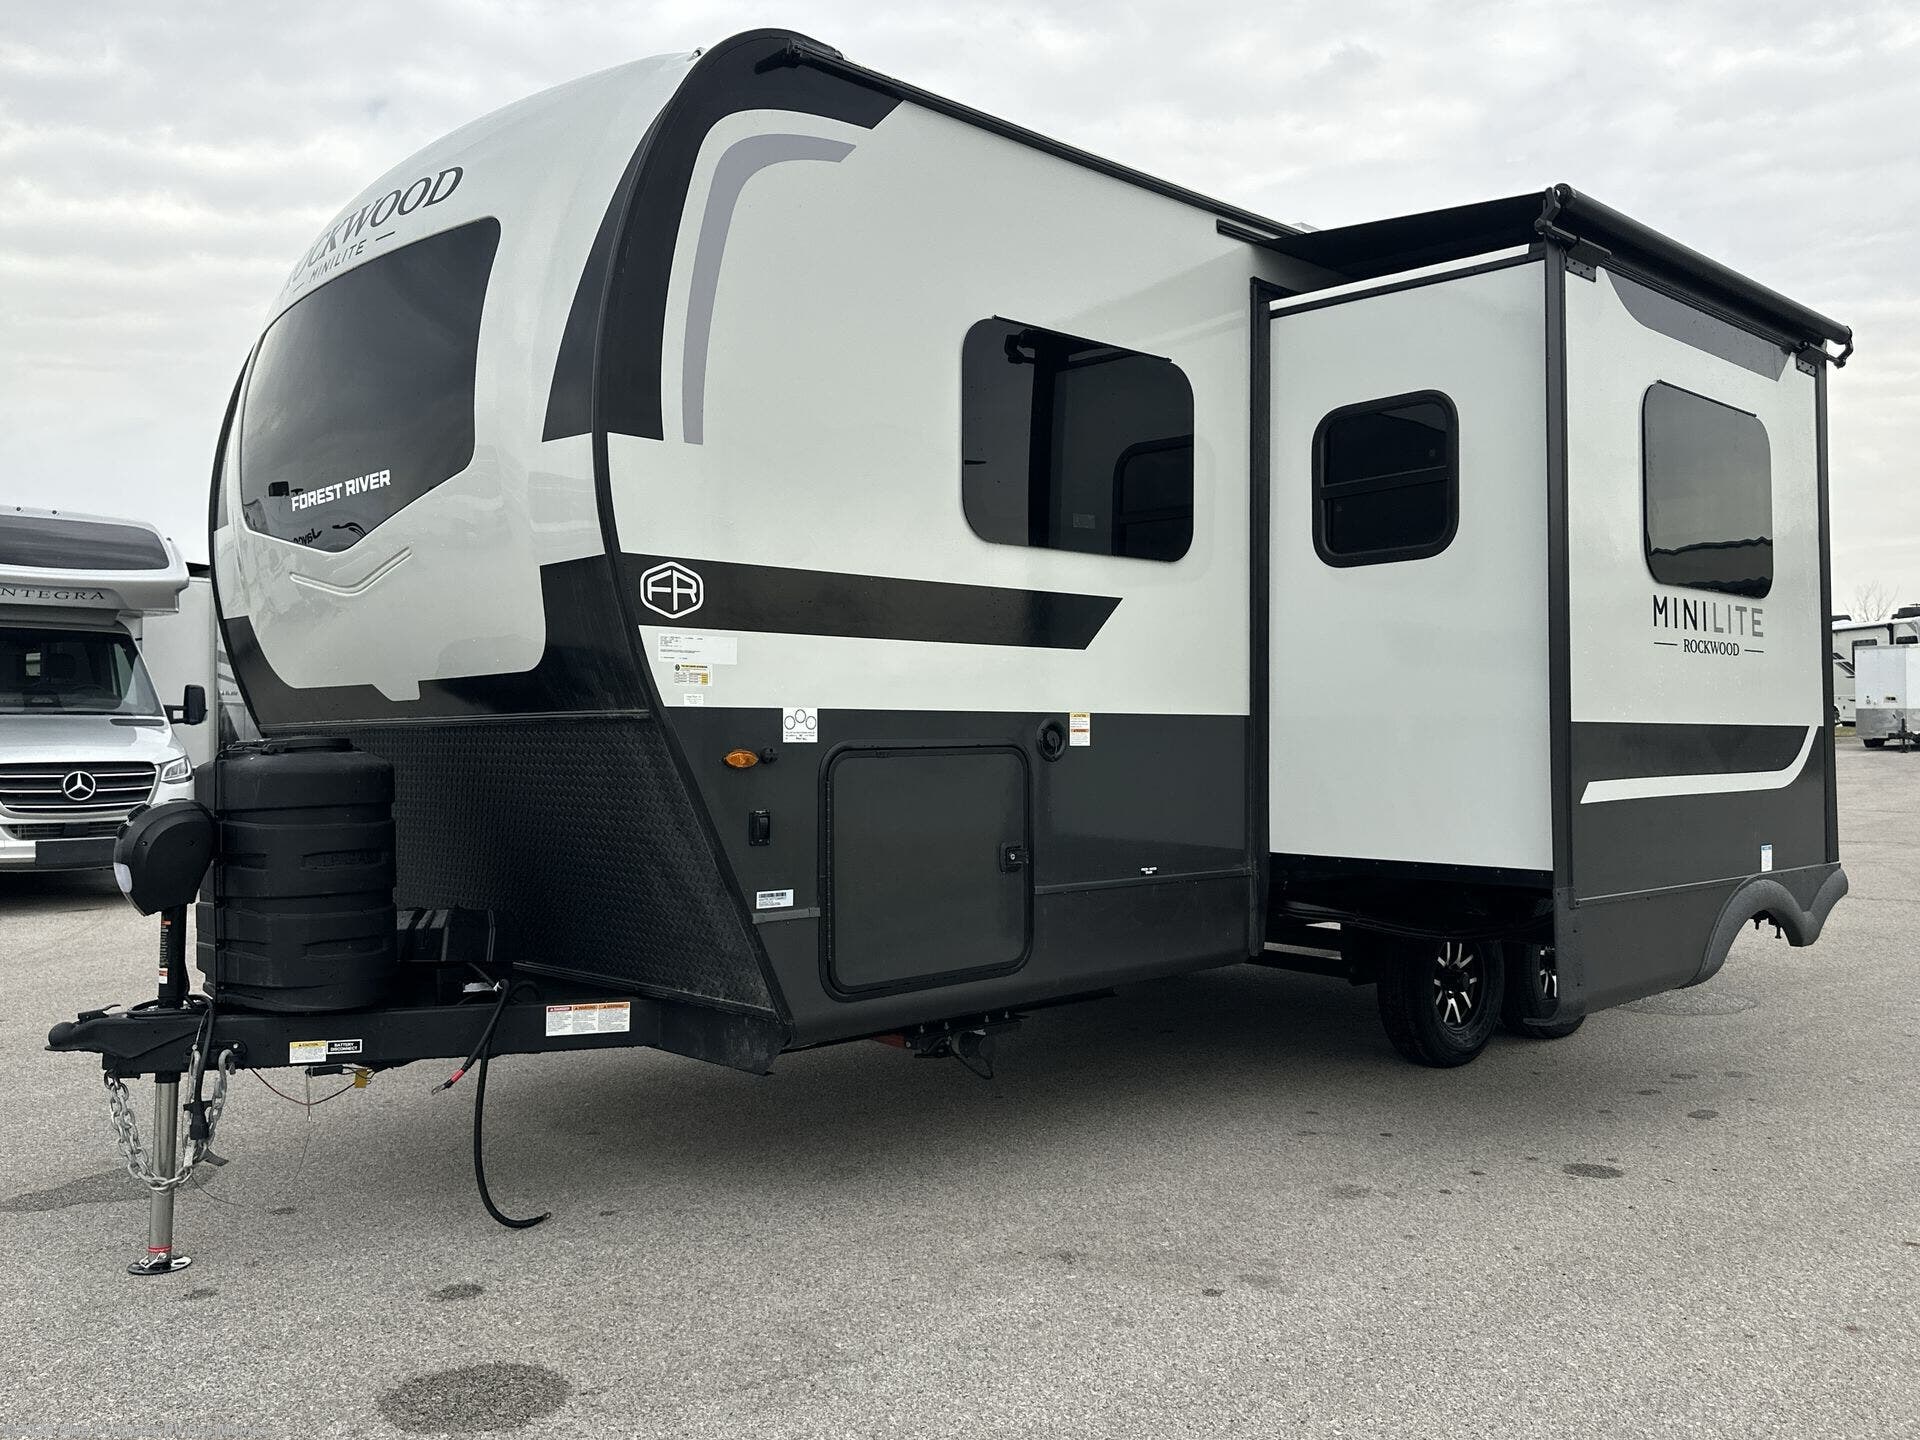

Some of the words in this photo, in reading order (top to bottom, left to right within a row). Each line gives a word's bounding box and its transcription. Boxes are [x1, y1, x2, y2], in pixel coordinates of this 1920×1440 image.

[282, 166, 463, 293] OCKWOOD
[310, 238, 367, 283] MINILITE
[291, 483, 343, 512] FOREST
[345, 469, 391, 497] RIVER
[0, 588, 105, 600] NTEGRA
[1653, 594, 1764, 637] MINILITE
[1683, 639, 1740, 656] ROCKWOOD
